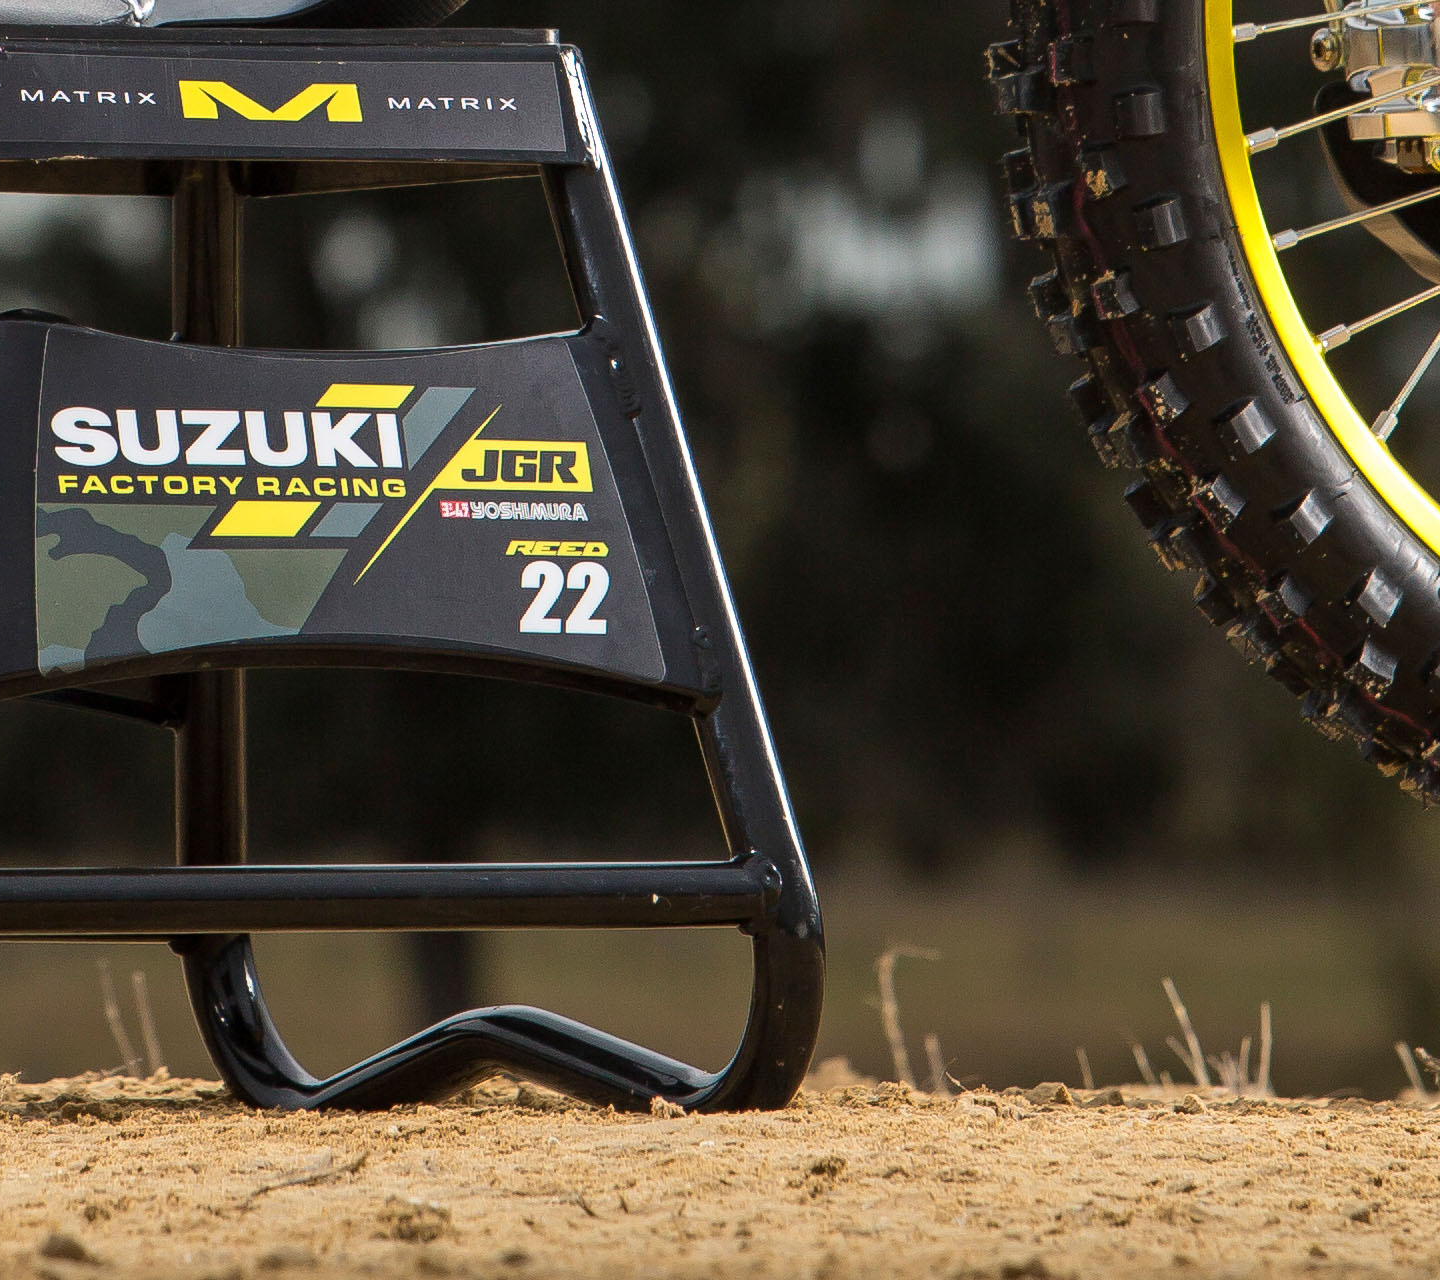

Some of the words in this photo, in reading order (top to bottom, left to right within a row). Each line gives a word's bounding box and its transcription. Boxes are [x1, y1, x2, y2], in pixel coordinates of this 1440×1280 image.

[20, 87, 157, 107] MATRIX
[387, 94, 518, 114] MATRIX
[50, 406, 405, 470] SUZUKI
[461, 449, 579, 484] JGR
[57, 475, 244, 496] FACTORY
[256, 476, 407, 498] RACING
[470, 500, 589, 522] YOSHIMURA
[505, 539, 610, 558] REED
[519, 559, 610, 635] 22
